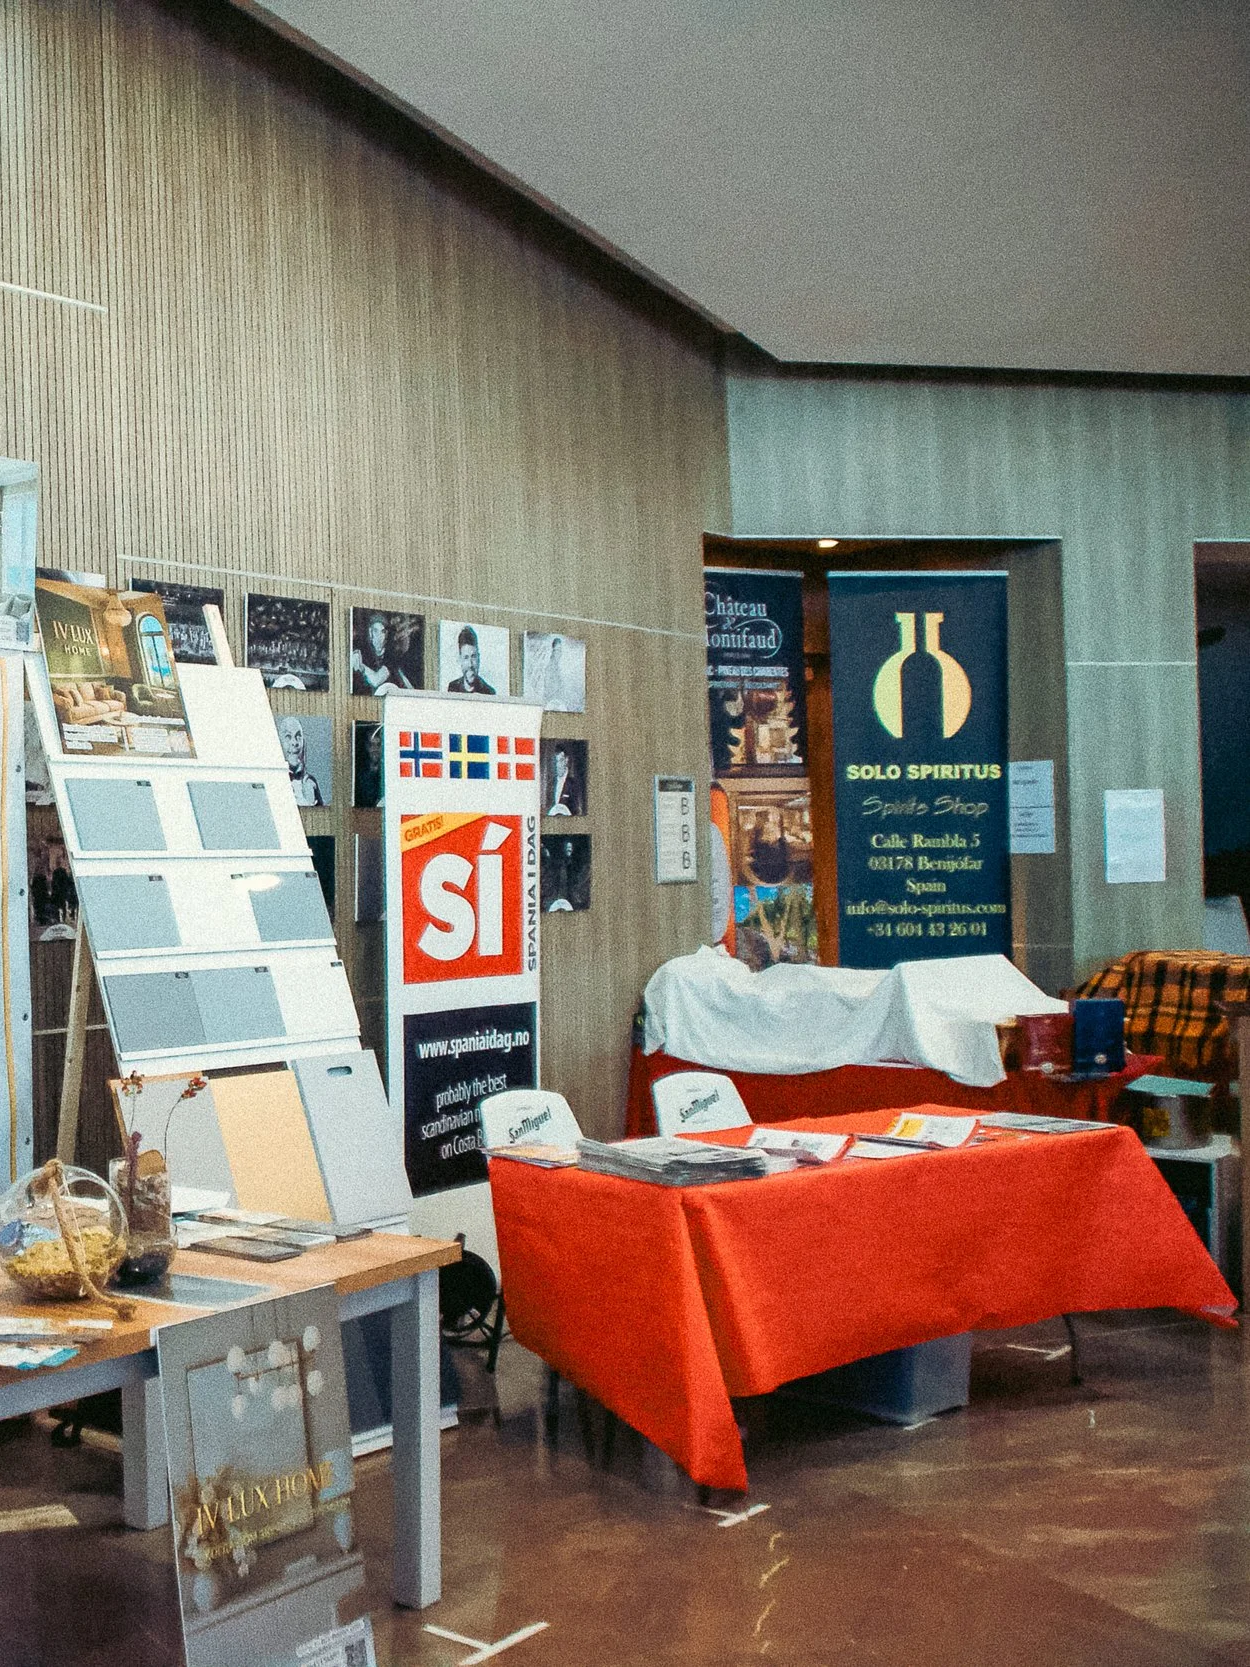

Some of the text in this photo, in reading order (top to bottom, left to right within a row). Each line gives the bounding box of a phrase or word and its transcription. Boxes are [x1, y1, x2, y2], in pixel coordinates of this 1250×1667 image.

[52, 620, 94, 645] IV LUX
[64, 644, 92, 657] HOME
[846, 764, 901, 780] SOLO
[906, 764, 1002, 780] SPIRITUS
[934, 795, 990, 819] Shop
[404, 815, 445, 842] GRATIS!
[527, 815, 537, 866] DAG
[871, 833, 981, 849] Calle Rambla 5
[906, 877, 947, 896] Spain
[846, 900, 1007, 917] info@solo-spiritus.com
[527, 883, 537, 972] SPANIA
[418, 1028, 530, 1059] www.spaniaidag.no
[435, 1073, 508, 1113] probably the best
[421, 1109, 474, 1140] scandinavian
[441, 1142, 453, 1159] on
[453, 1133, 476, 1155] Costa
[227, 1485, 270, 1523] LUX
